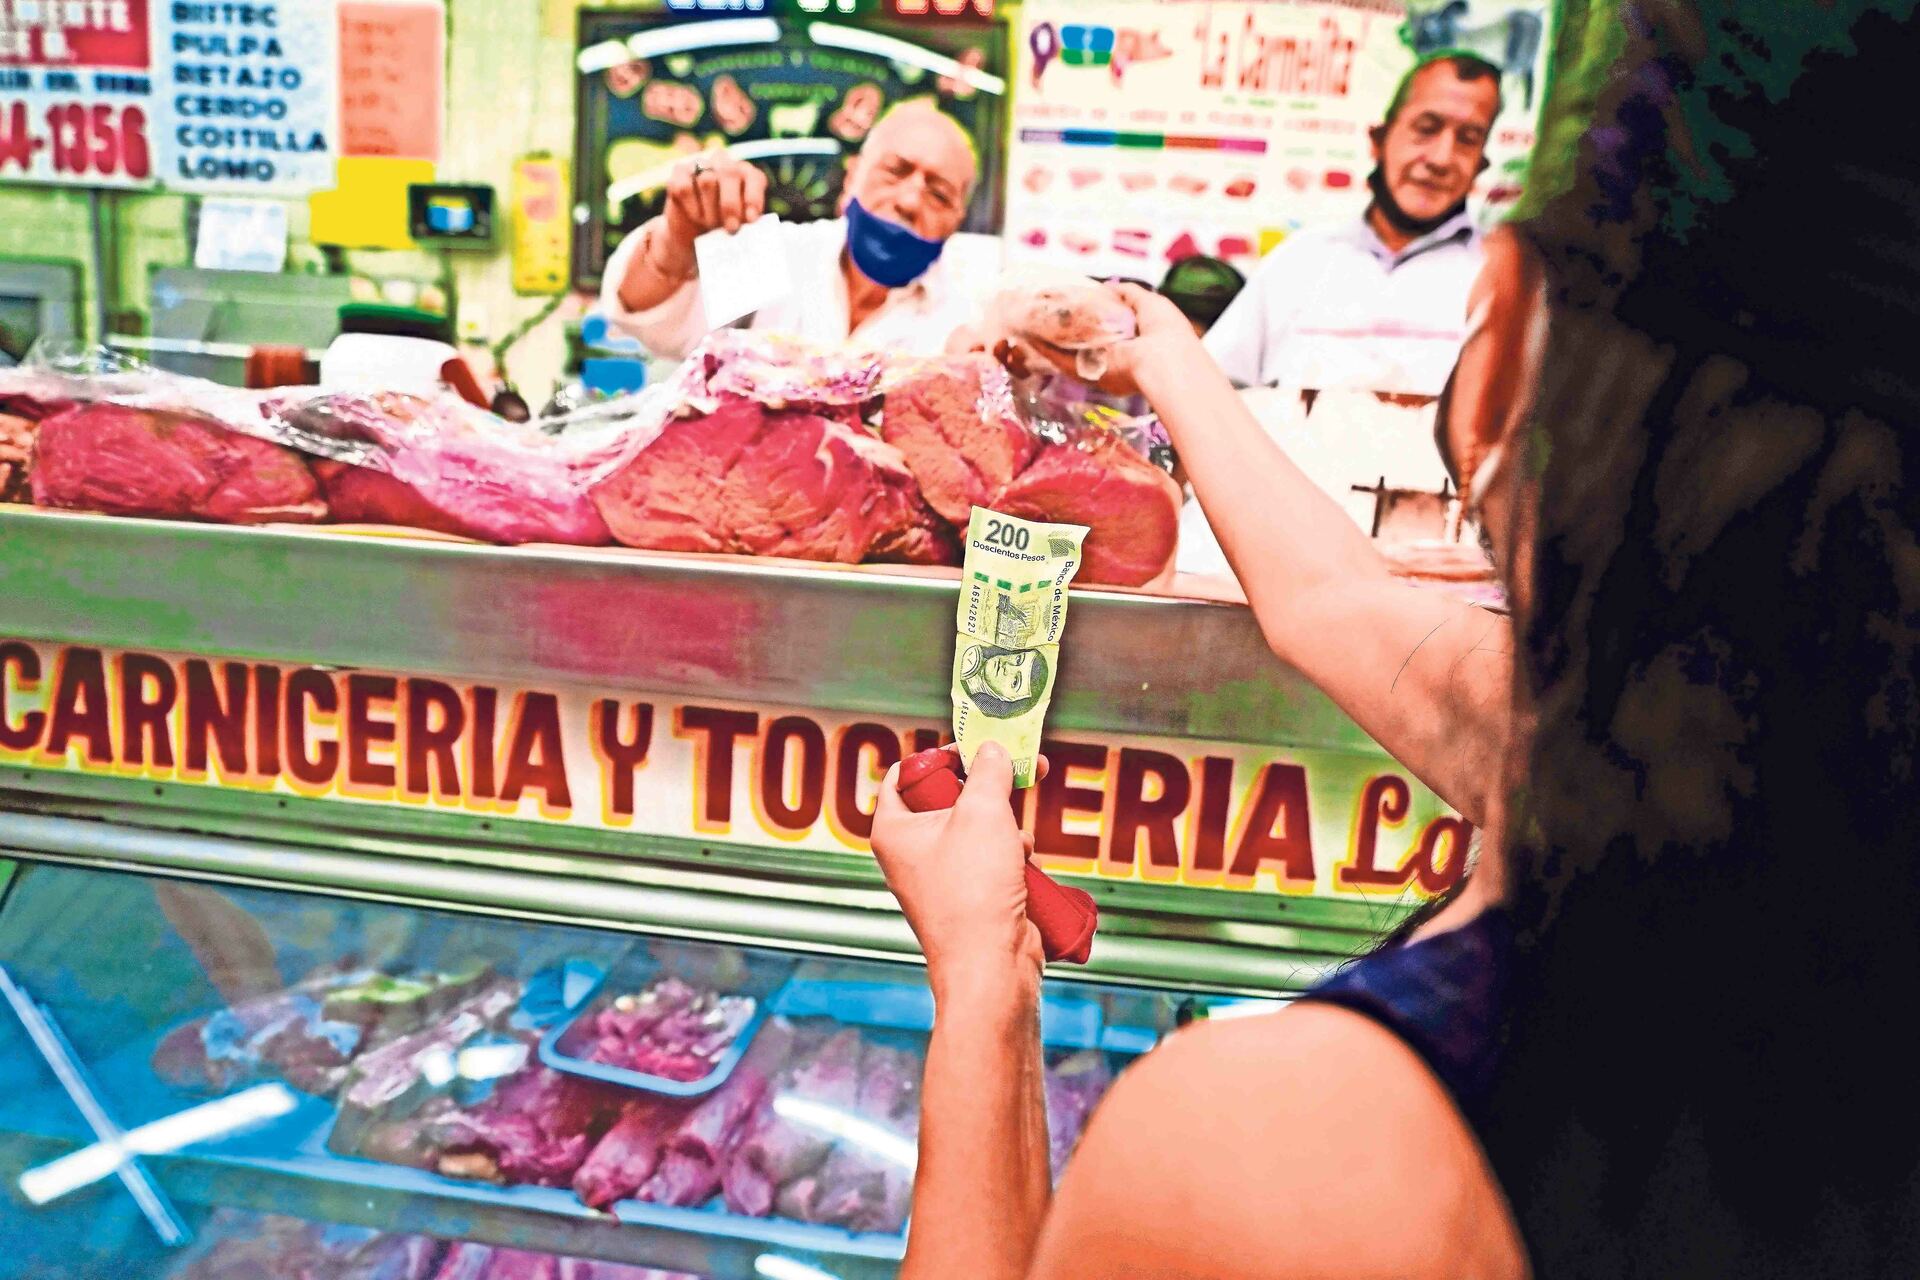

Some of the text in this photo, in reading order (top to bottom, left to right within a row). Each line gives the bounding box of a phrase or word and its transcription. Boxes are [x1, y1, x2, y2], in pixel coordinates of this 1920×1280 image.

[172, 32, 283, 57] PULPA
[175, 94, 287, 120] CERDO
[176, 124, 327, 151] COSTILLA
[178, 156, 275, 182] LOMO
[985, 519, 1030, 551] 200
[973, 540, 1046, 562] Doscientos Pesos
[1048, 560, 1075, 641] Banco de México
[0, 640, 1475, 893] CARNICERIA Y TOCERIA La
